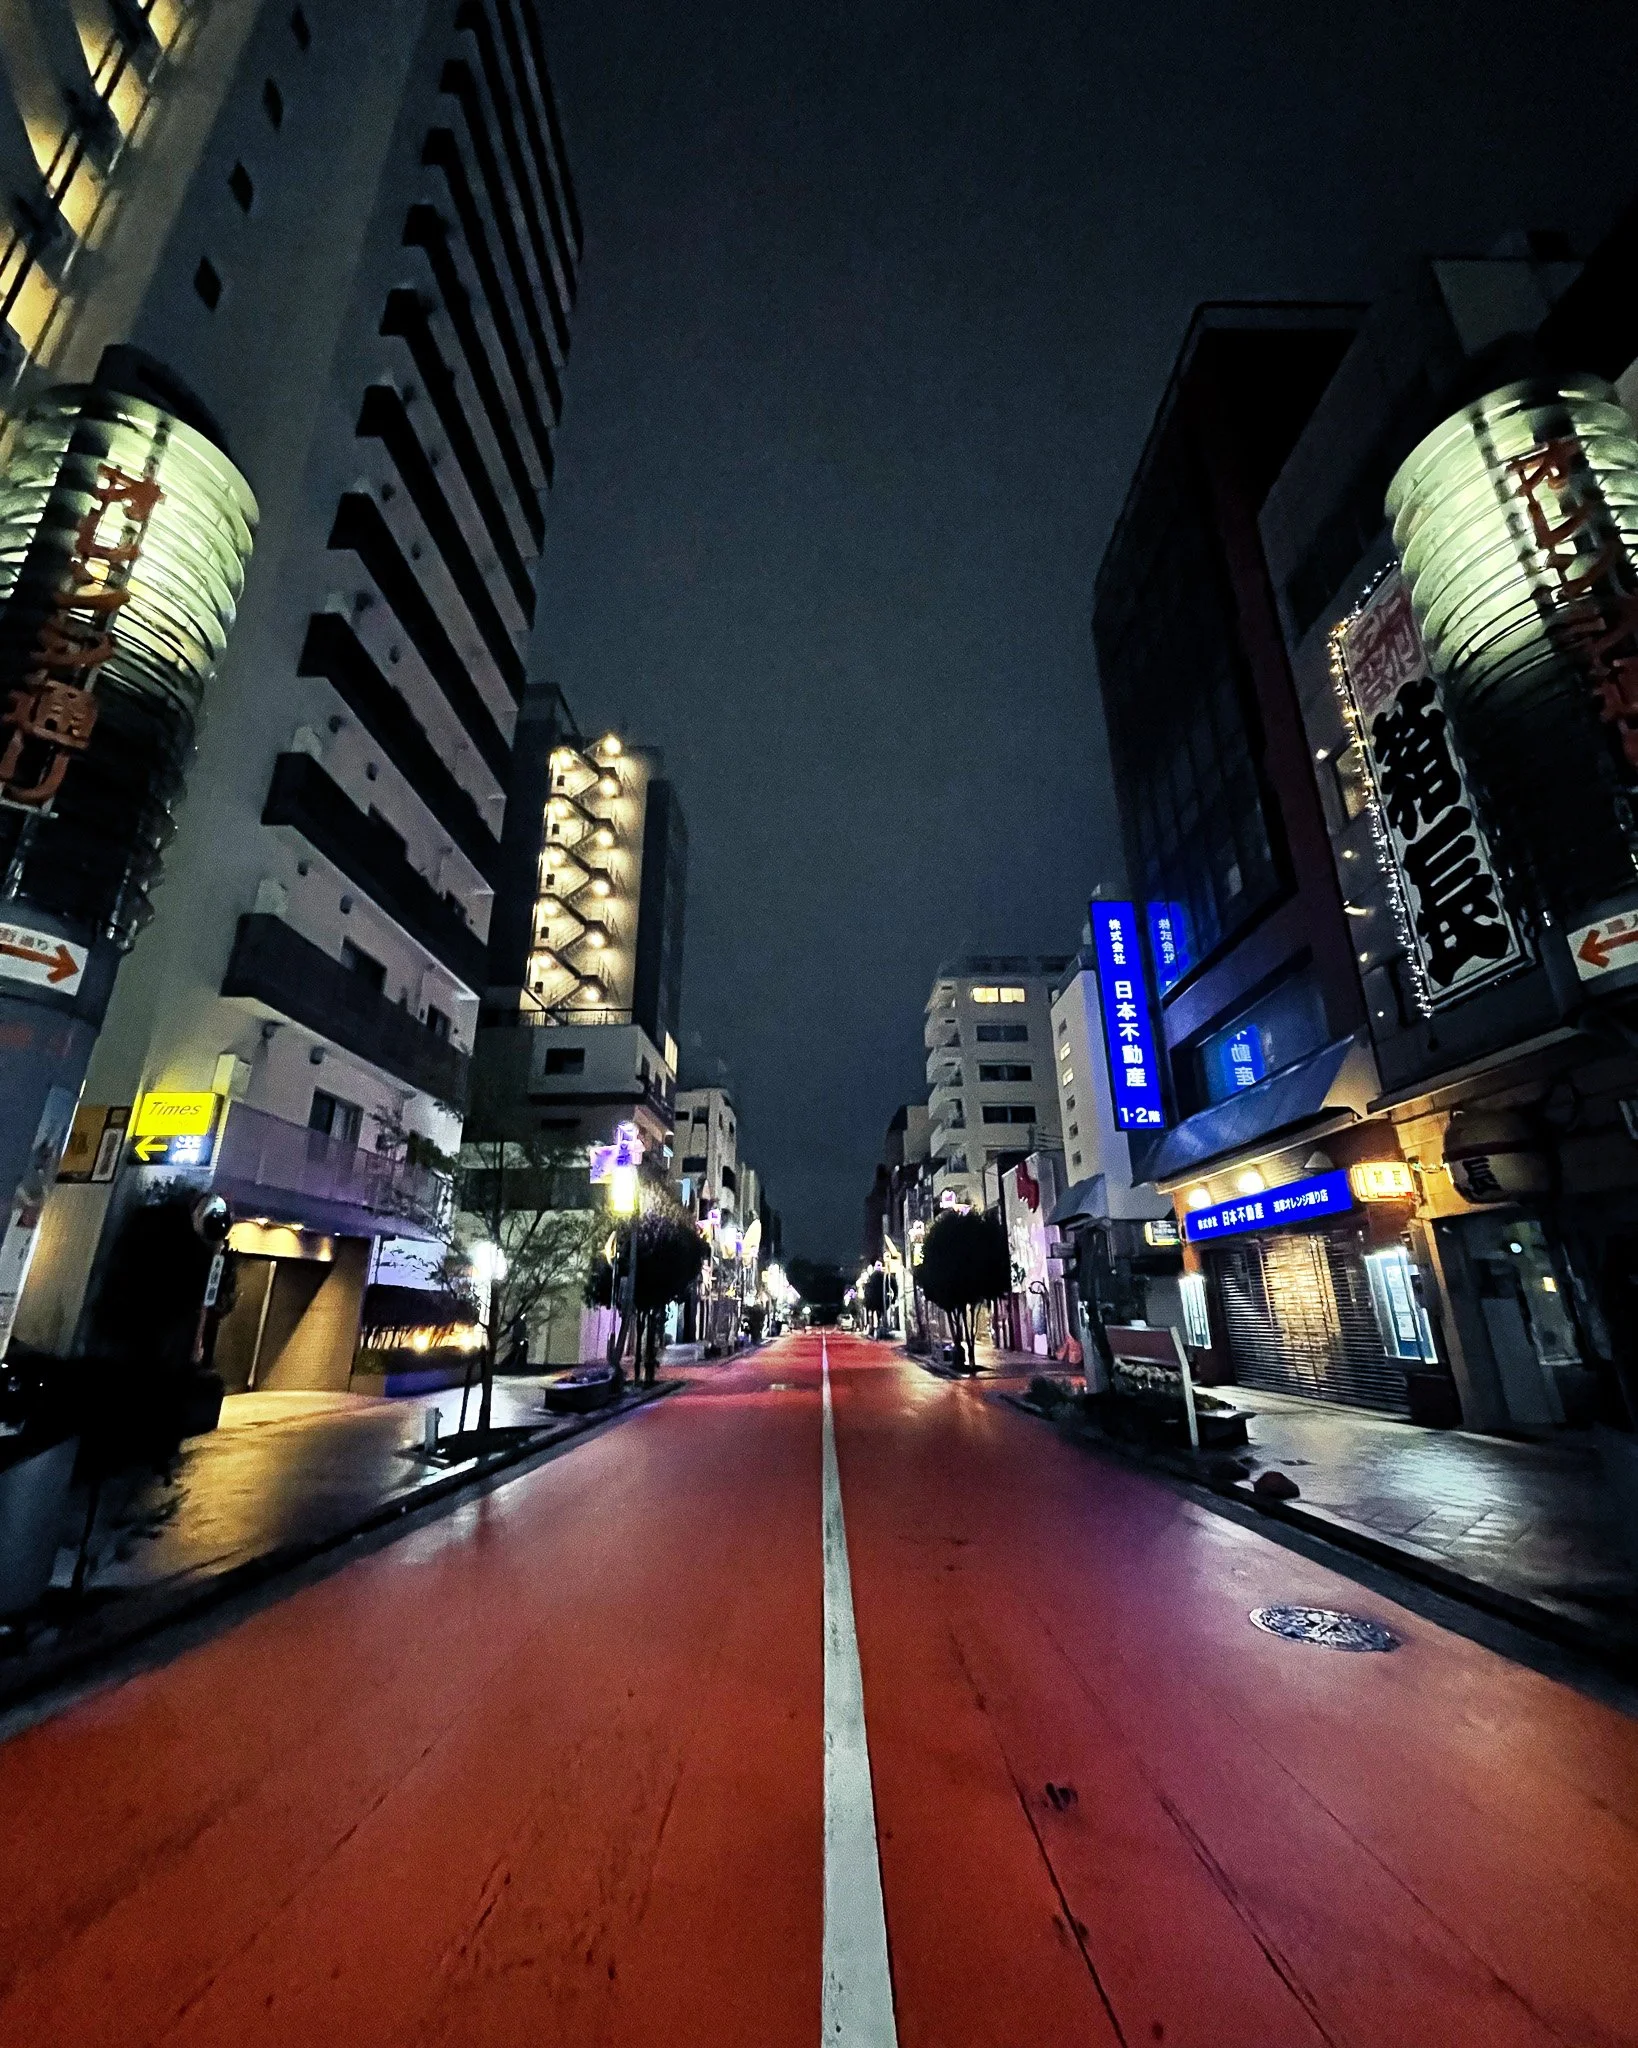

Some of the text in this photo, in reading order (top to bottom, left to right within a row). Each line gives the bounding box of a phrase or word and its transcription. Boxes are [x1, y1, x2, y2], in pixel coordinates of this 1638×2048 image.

[1108, 919, 1147, 1087] 株式会社 日本不動産
[148, 1101, 202, 1116] Times
[1197, 1215, 1219, 1231] 株式会社
[1221, 1202, 1265, 1227] 日本不動産
[1273, 1188, 1329, 1213] 浅草オレンジ通り店
